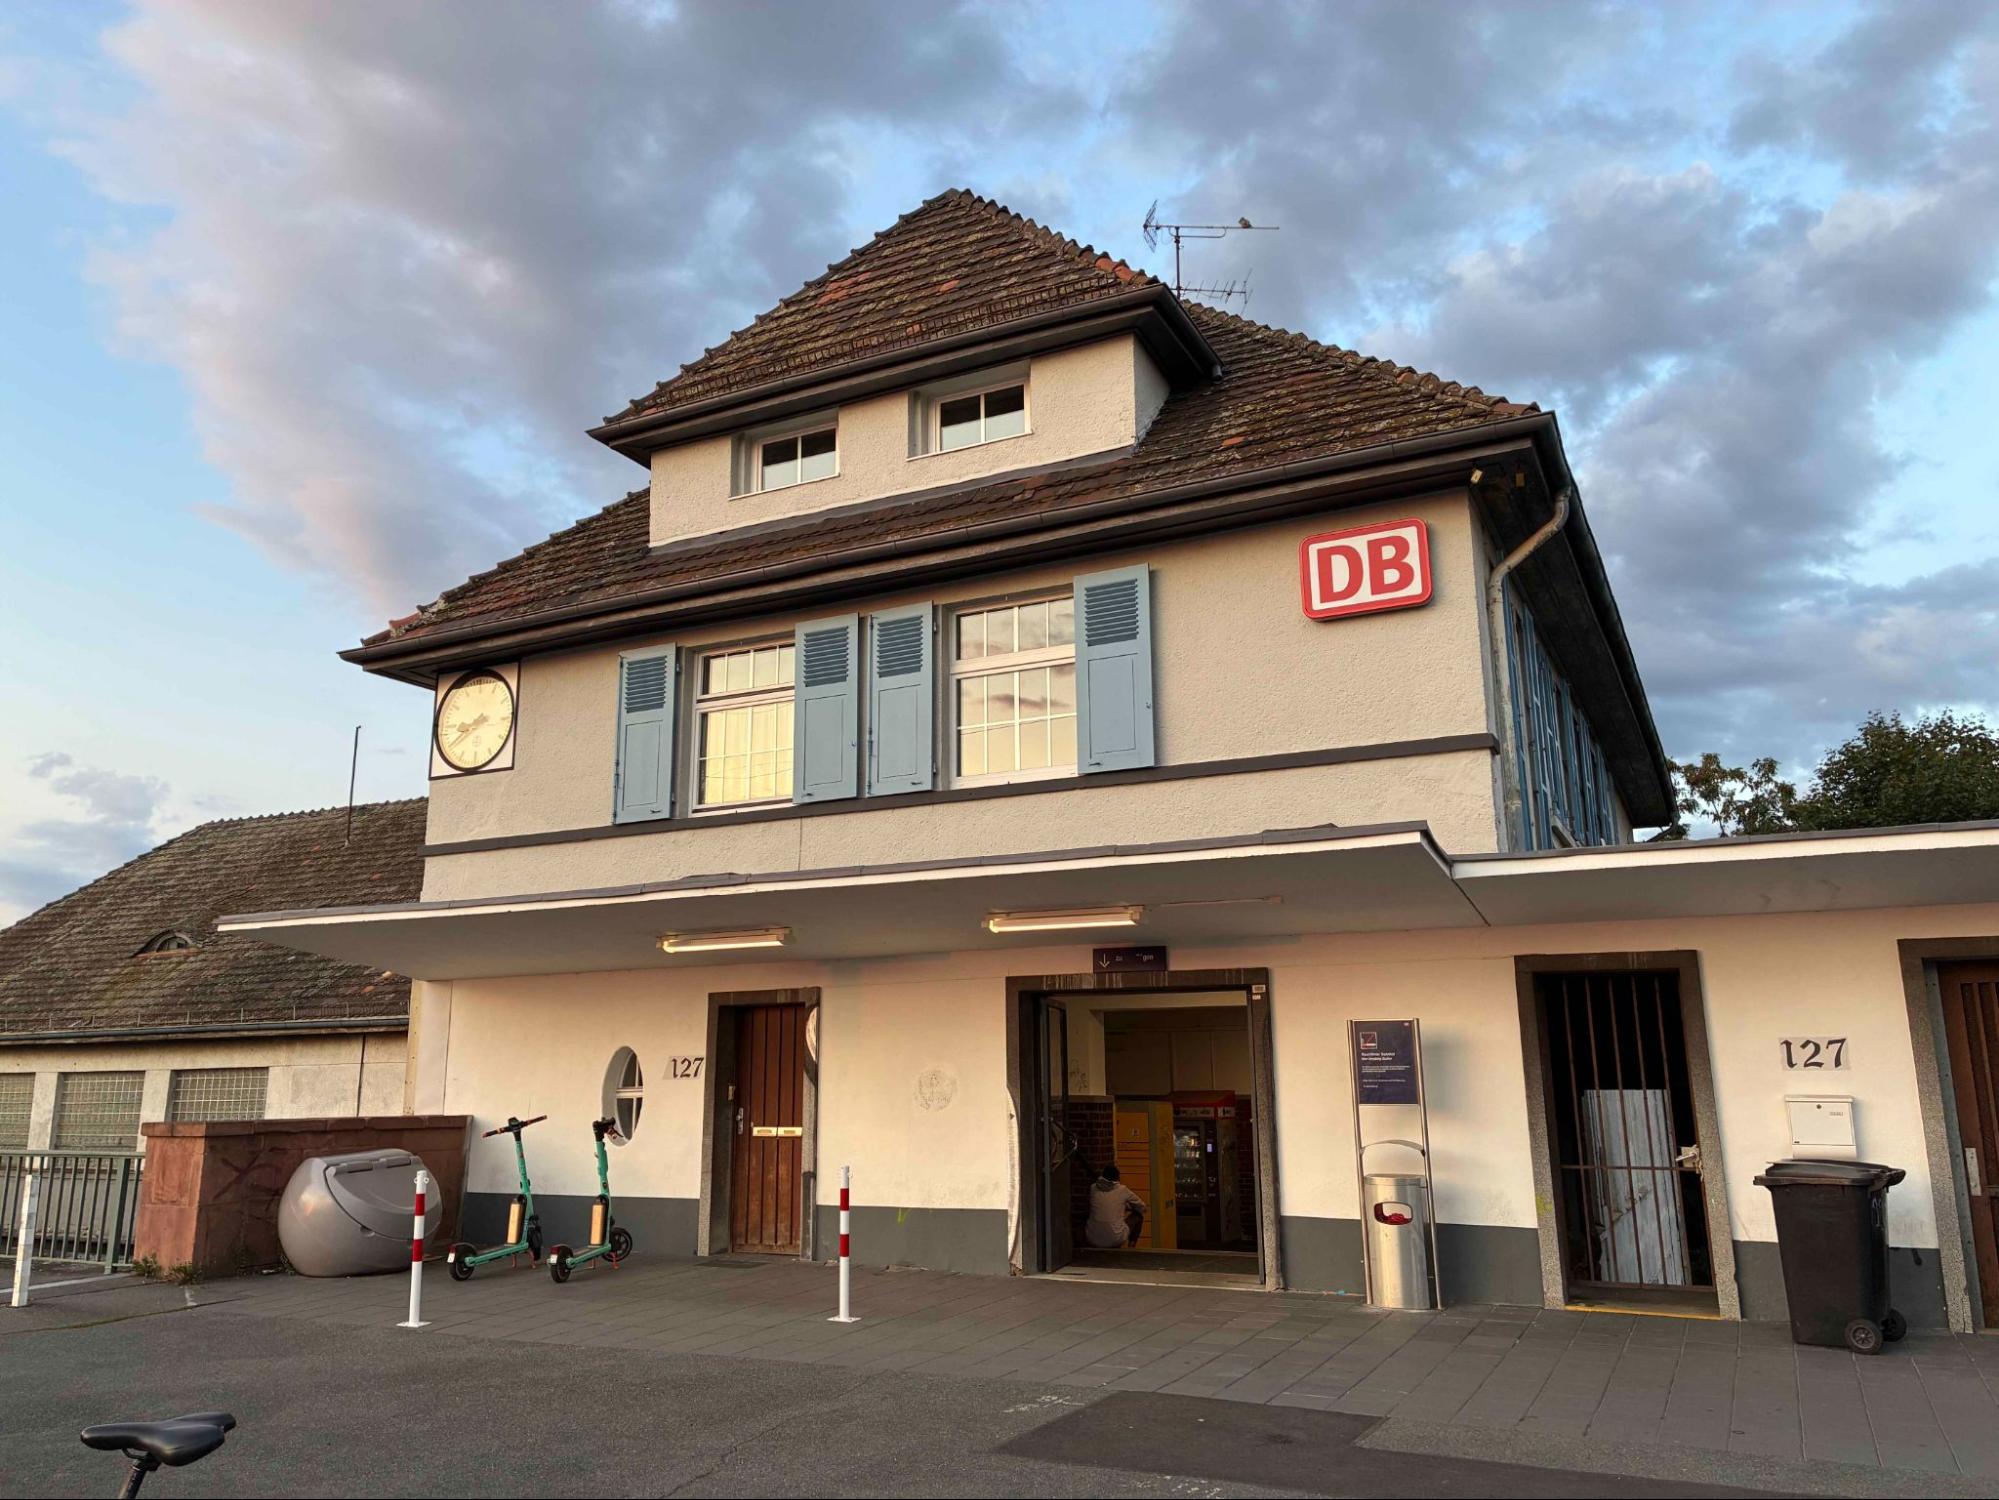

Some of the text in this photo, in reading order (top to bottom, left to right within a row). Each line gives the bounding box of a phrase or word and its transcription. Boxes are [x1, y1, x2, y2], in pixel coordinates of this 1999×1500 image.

[1317, 535, 1414, 603] DB
[671, 1057, 705, 1078] 127
[1780, 1038, 1847, 1068] 127
